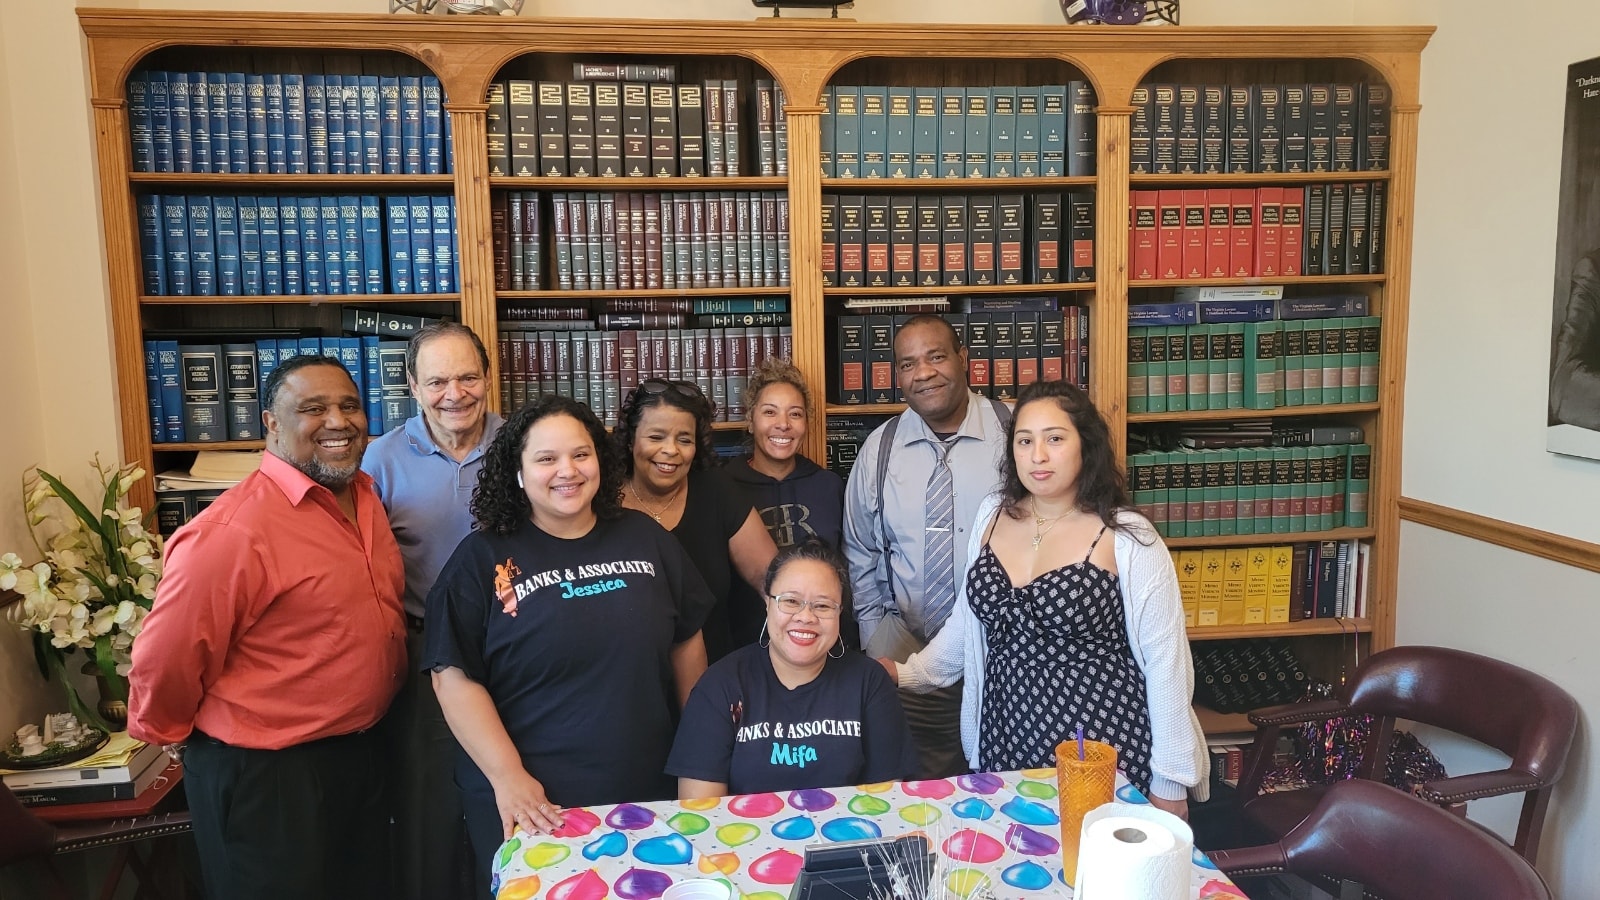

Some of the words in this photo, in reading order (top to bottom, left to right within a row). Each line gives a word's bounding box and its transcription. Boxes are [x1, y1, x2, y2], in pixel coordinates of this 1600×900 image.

[514, 570, 562, 602] BANKS
[564, 568, 576, 581] &
[560, 578, 627, 599] Jessica
[736, 722, 770, 742] ANKS
[774, 722, 783, 738] &
[788, 720, 861, 738] ASSOCIATE
[770, 742, 818, 768] Mifa
